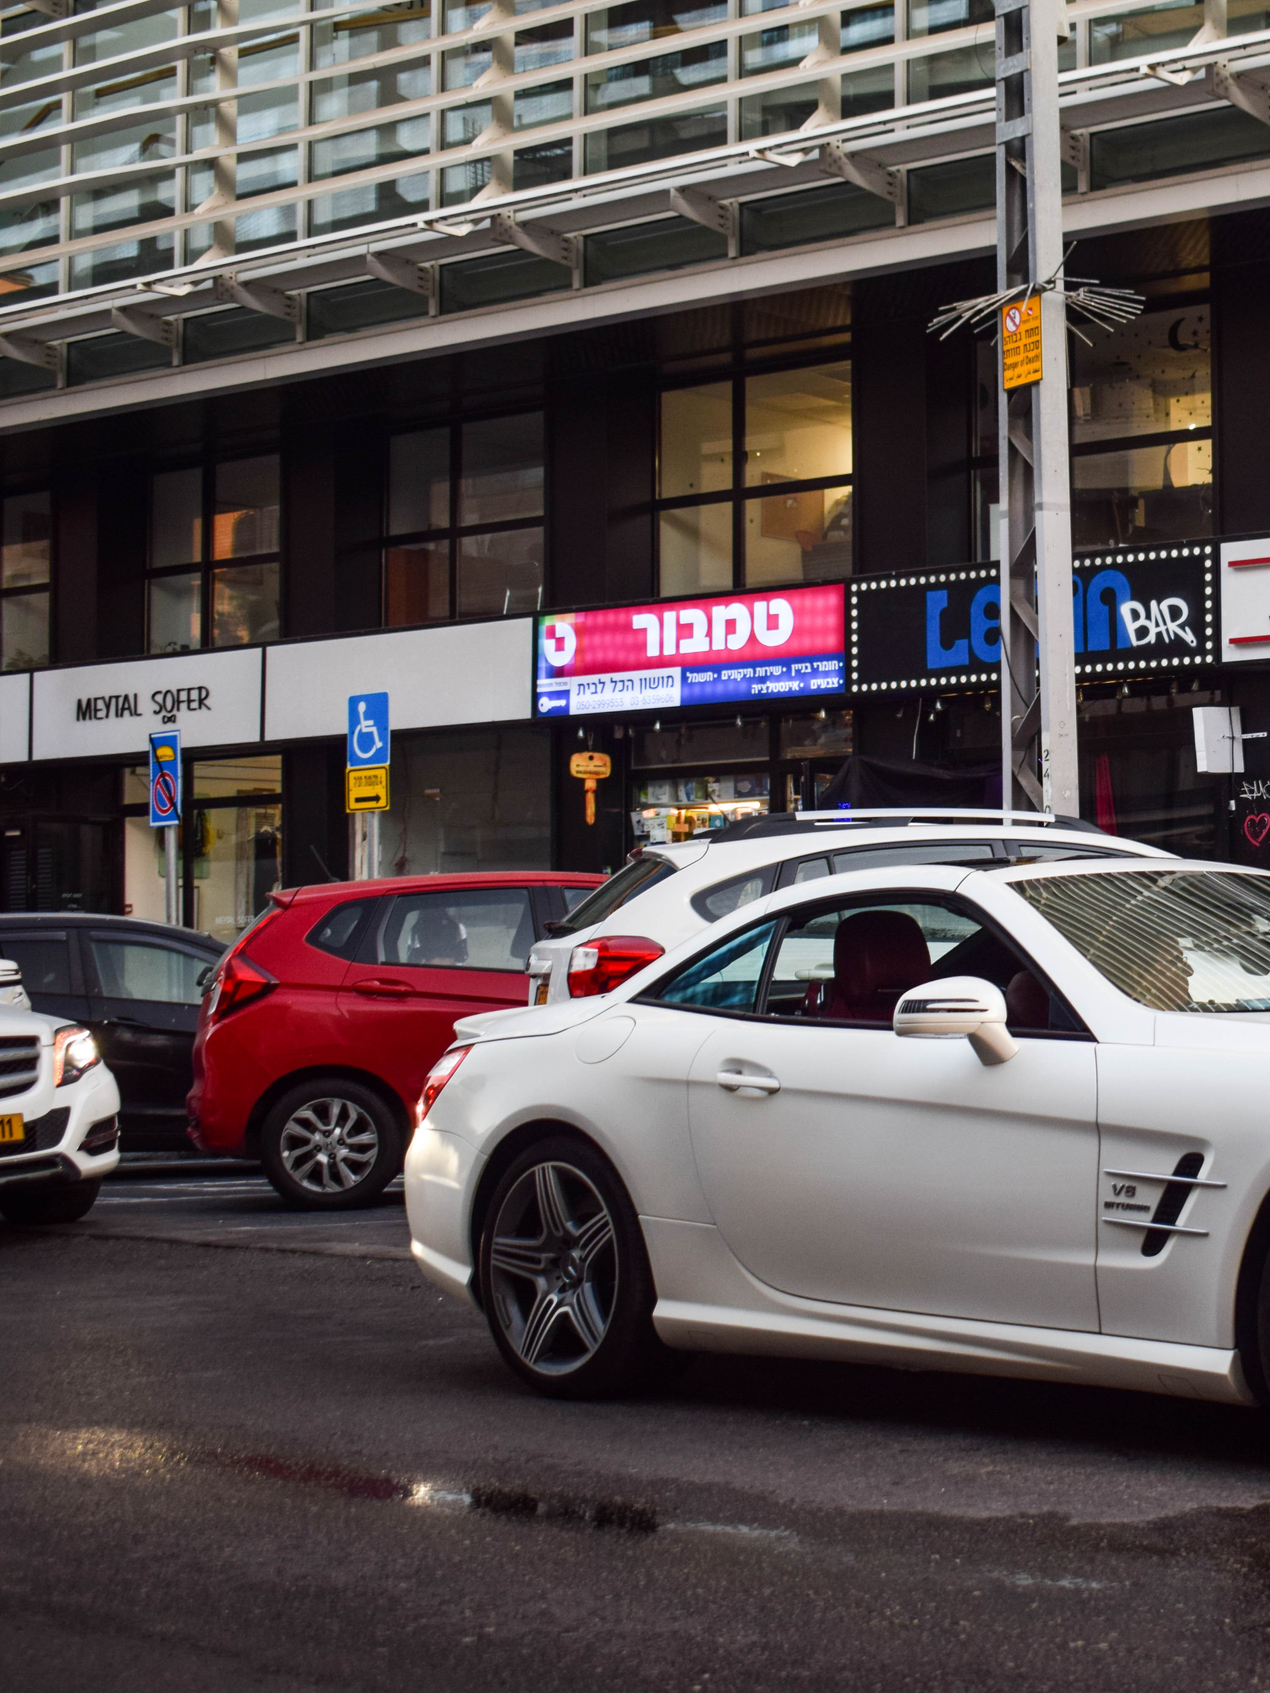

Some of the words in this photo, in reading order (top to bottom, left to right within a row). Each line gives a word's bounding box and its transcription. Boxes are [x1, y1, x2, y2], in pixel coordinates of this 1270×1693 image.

[632, 598, 794, 657] טמבור
[1120, 597, 1197, 647] BAR
[686, 671, 713, 683] חשמל
[721, 669, 753, 681] תיקונים
[755, 666, 782, 677] שירות
[576, 677, 606, 696] לבית
[610, 677, 634, 693] הכל
[639, 675, 675, 694] מושון
[751, 681, 800, 694] אינסטלציה
[810, 677, 839, 690] צבעים
[76, 693, 142, 721] MEYTAL
[151, 686, 211, 715] SOFER
[1111, 1182, 1136, 1198] V8
